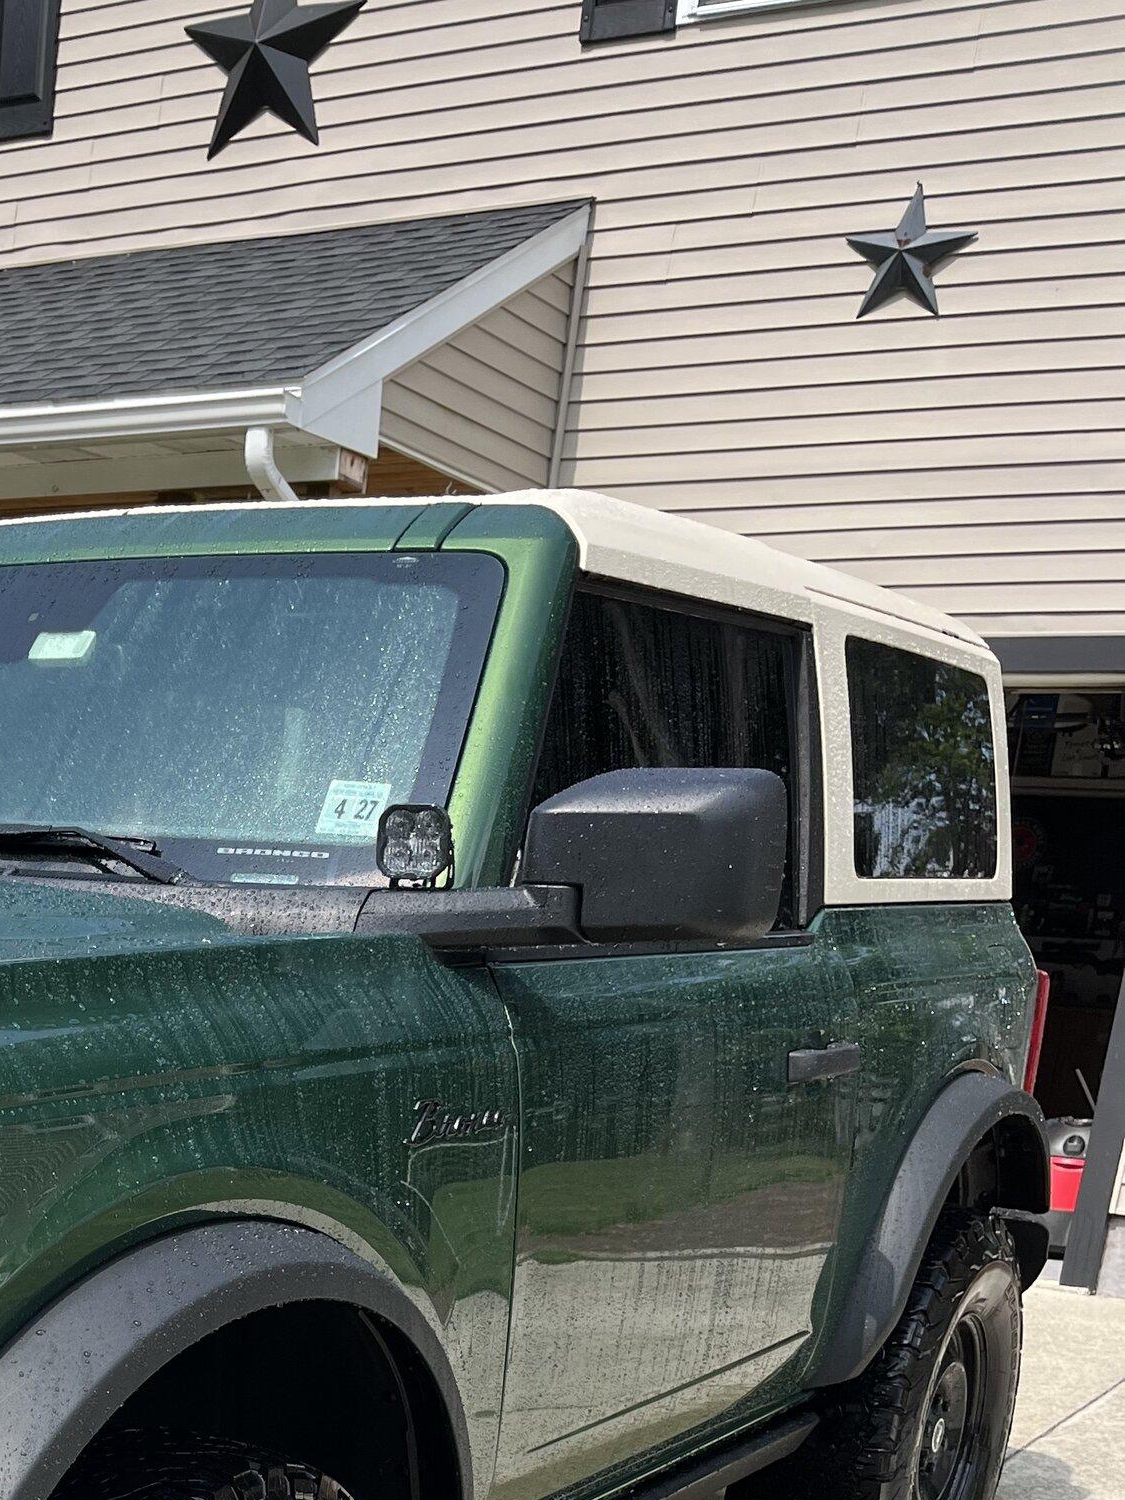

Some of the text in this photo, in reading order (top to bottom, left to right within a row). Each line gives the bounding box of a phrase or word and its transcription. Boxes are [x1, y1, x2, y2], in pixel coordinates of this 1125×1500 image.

[334, 798, 380, 821] 4 27
[216, 847, 330, 859] BRONCO
